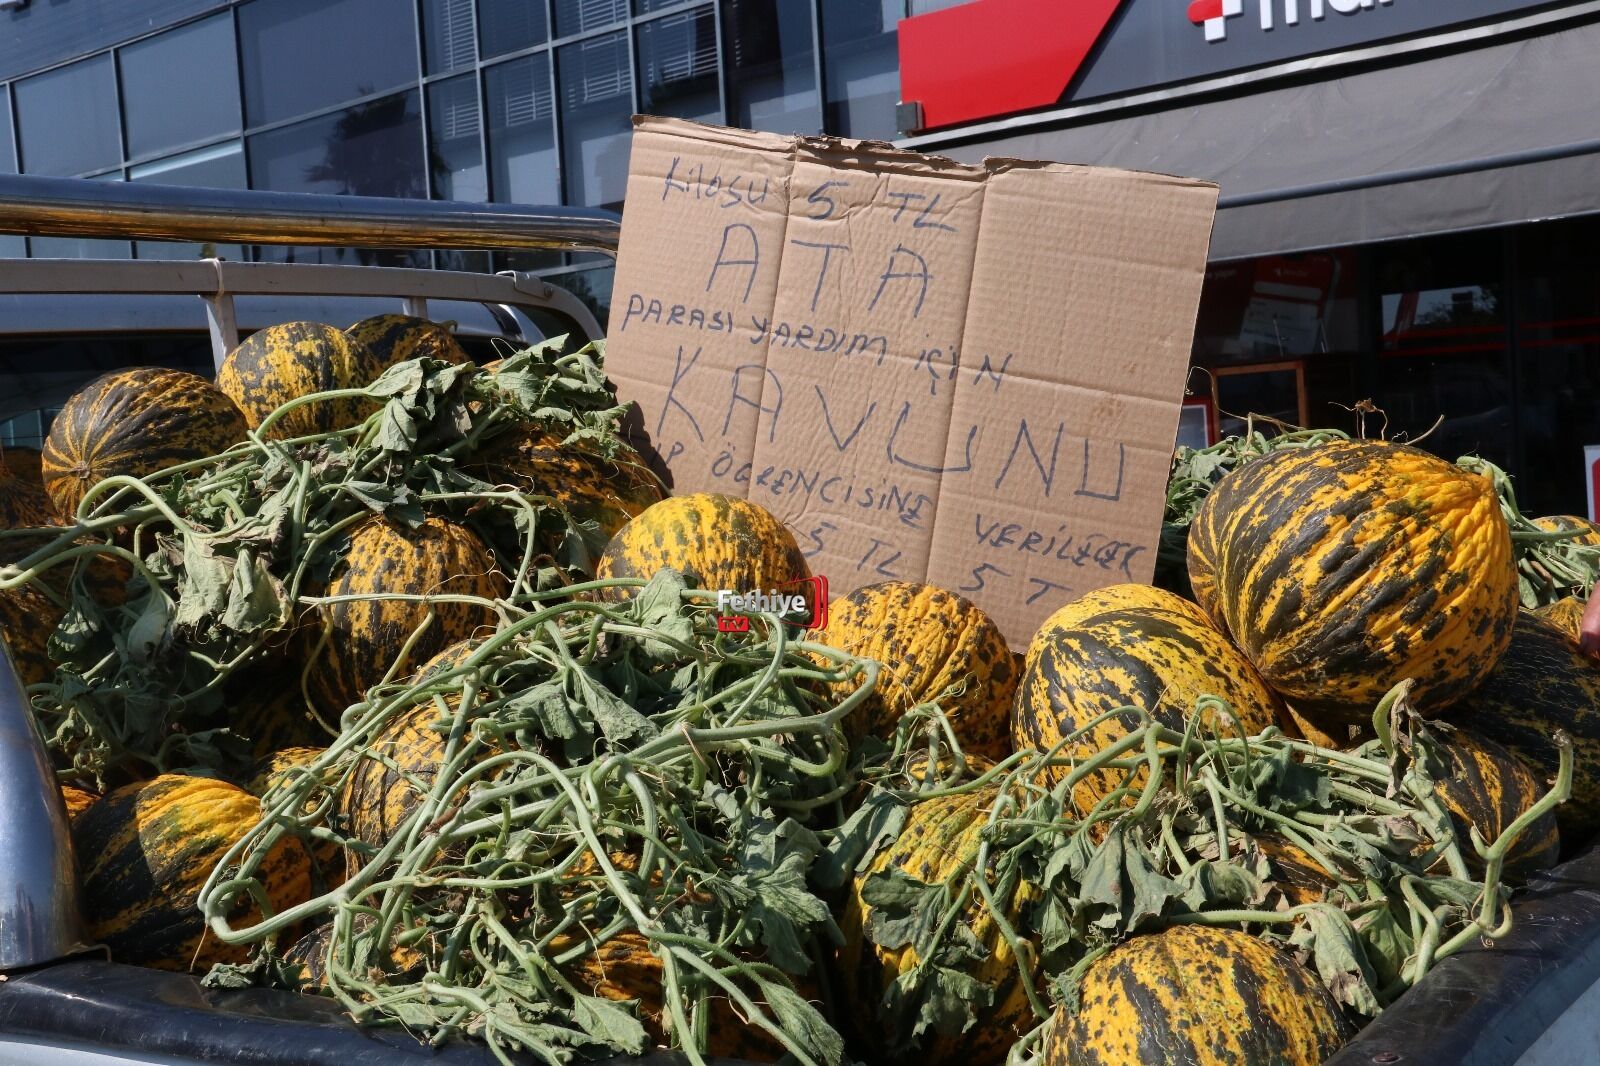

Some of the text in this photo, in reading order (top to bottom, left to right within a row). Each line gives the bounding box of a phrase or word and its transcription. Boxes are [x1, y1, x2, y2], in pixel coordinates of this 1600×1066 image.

[806, 180, 848, 220] 5
[887, 191, 957, 232] TL
[621, 293, 733, 331] PARASI
[750, 314, 887, 366] YARDIM
[655, 345, 1125, 501] KAVUNU
[803, 521, 838, 558] 5
[856, 537, 903, 577] TL
